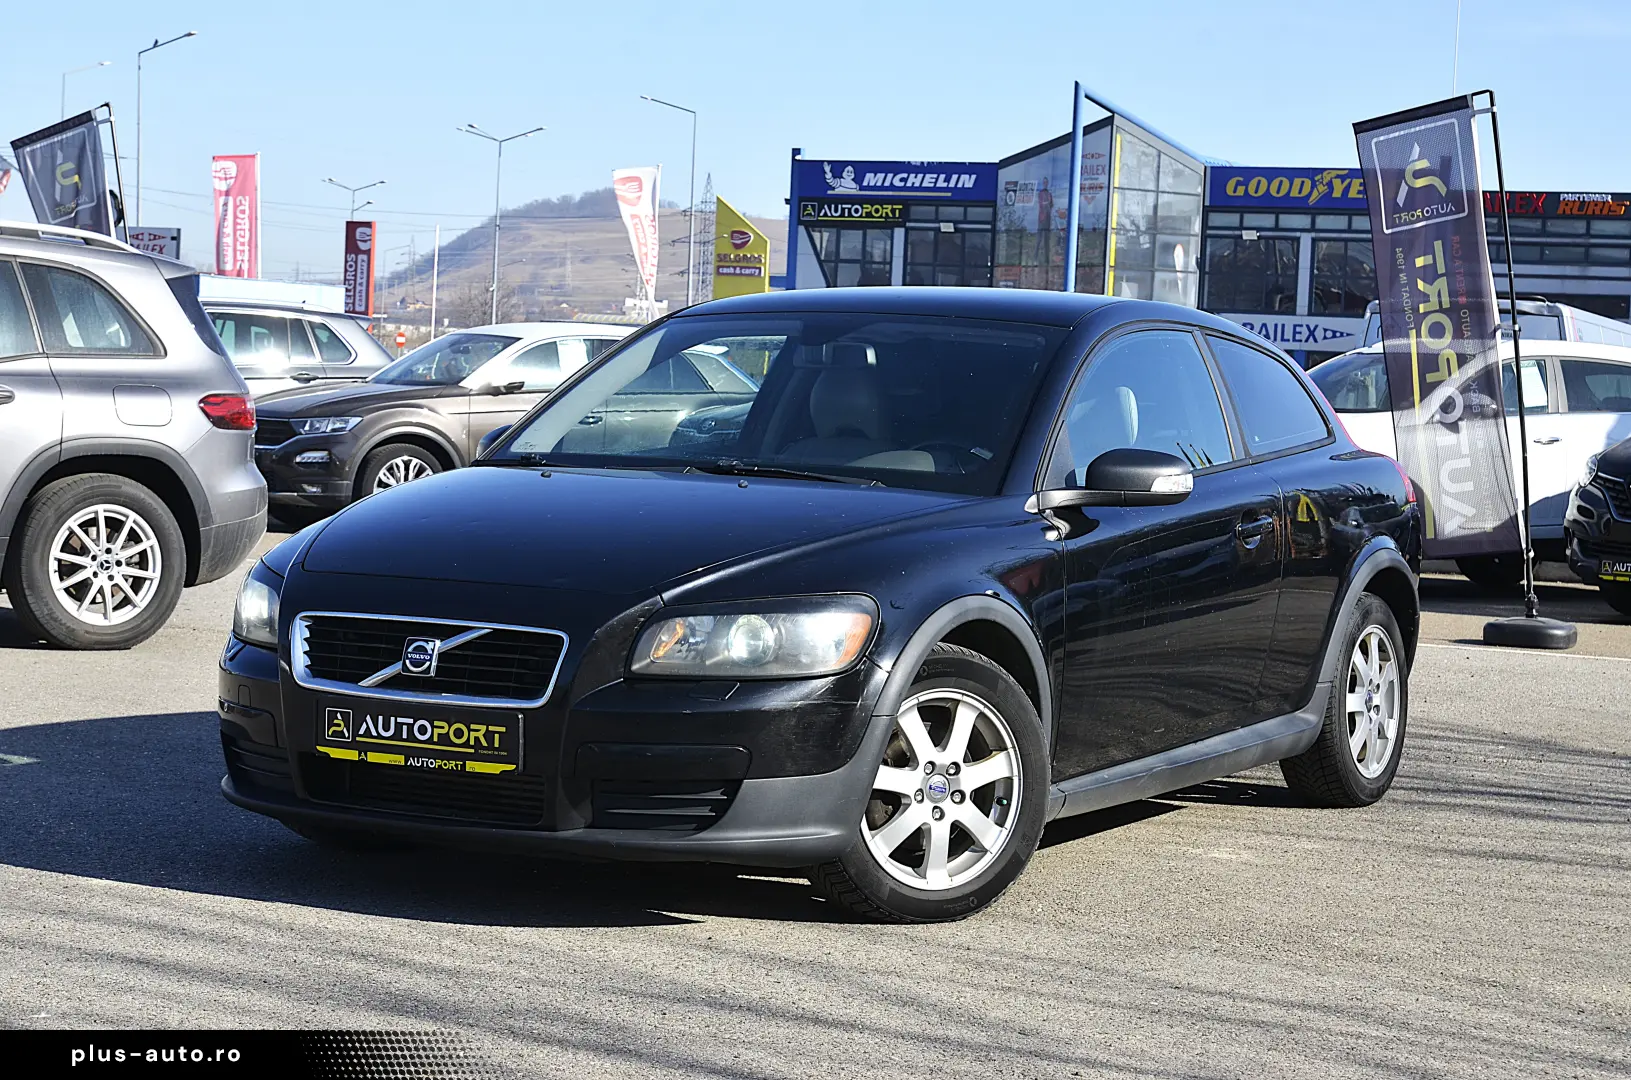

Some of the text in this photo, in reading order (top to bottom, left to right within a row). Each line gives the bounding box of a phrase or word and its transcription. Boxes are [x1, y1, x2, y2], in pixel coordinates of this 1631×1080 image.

[862, 172, 977, 188] MICHELIN
[1225, 176, 1364, 199] GOODYE
[820, 204, 903, 218] AUTOPORT
[1483, 192, 1546, 214] AILEX
[717, 253, 764, 264] SELGROS
[742, 268, 760, 276] carry
[345, 254, 356, 311] SELGROS
[358, 714, 506, 748] AUTOPORT
[407, 757, 463, 771] AUTOPORT
